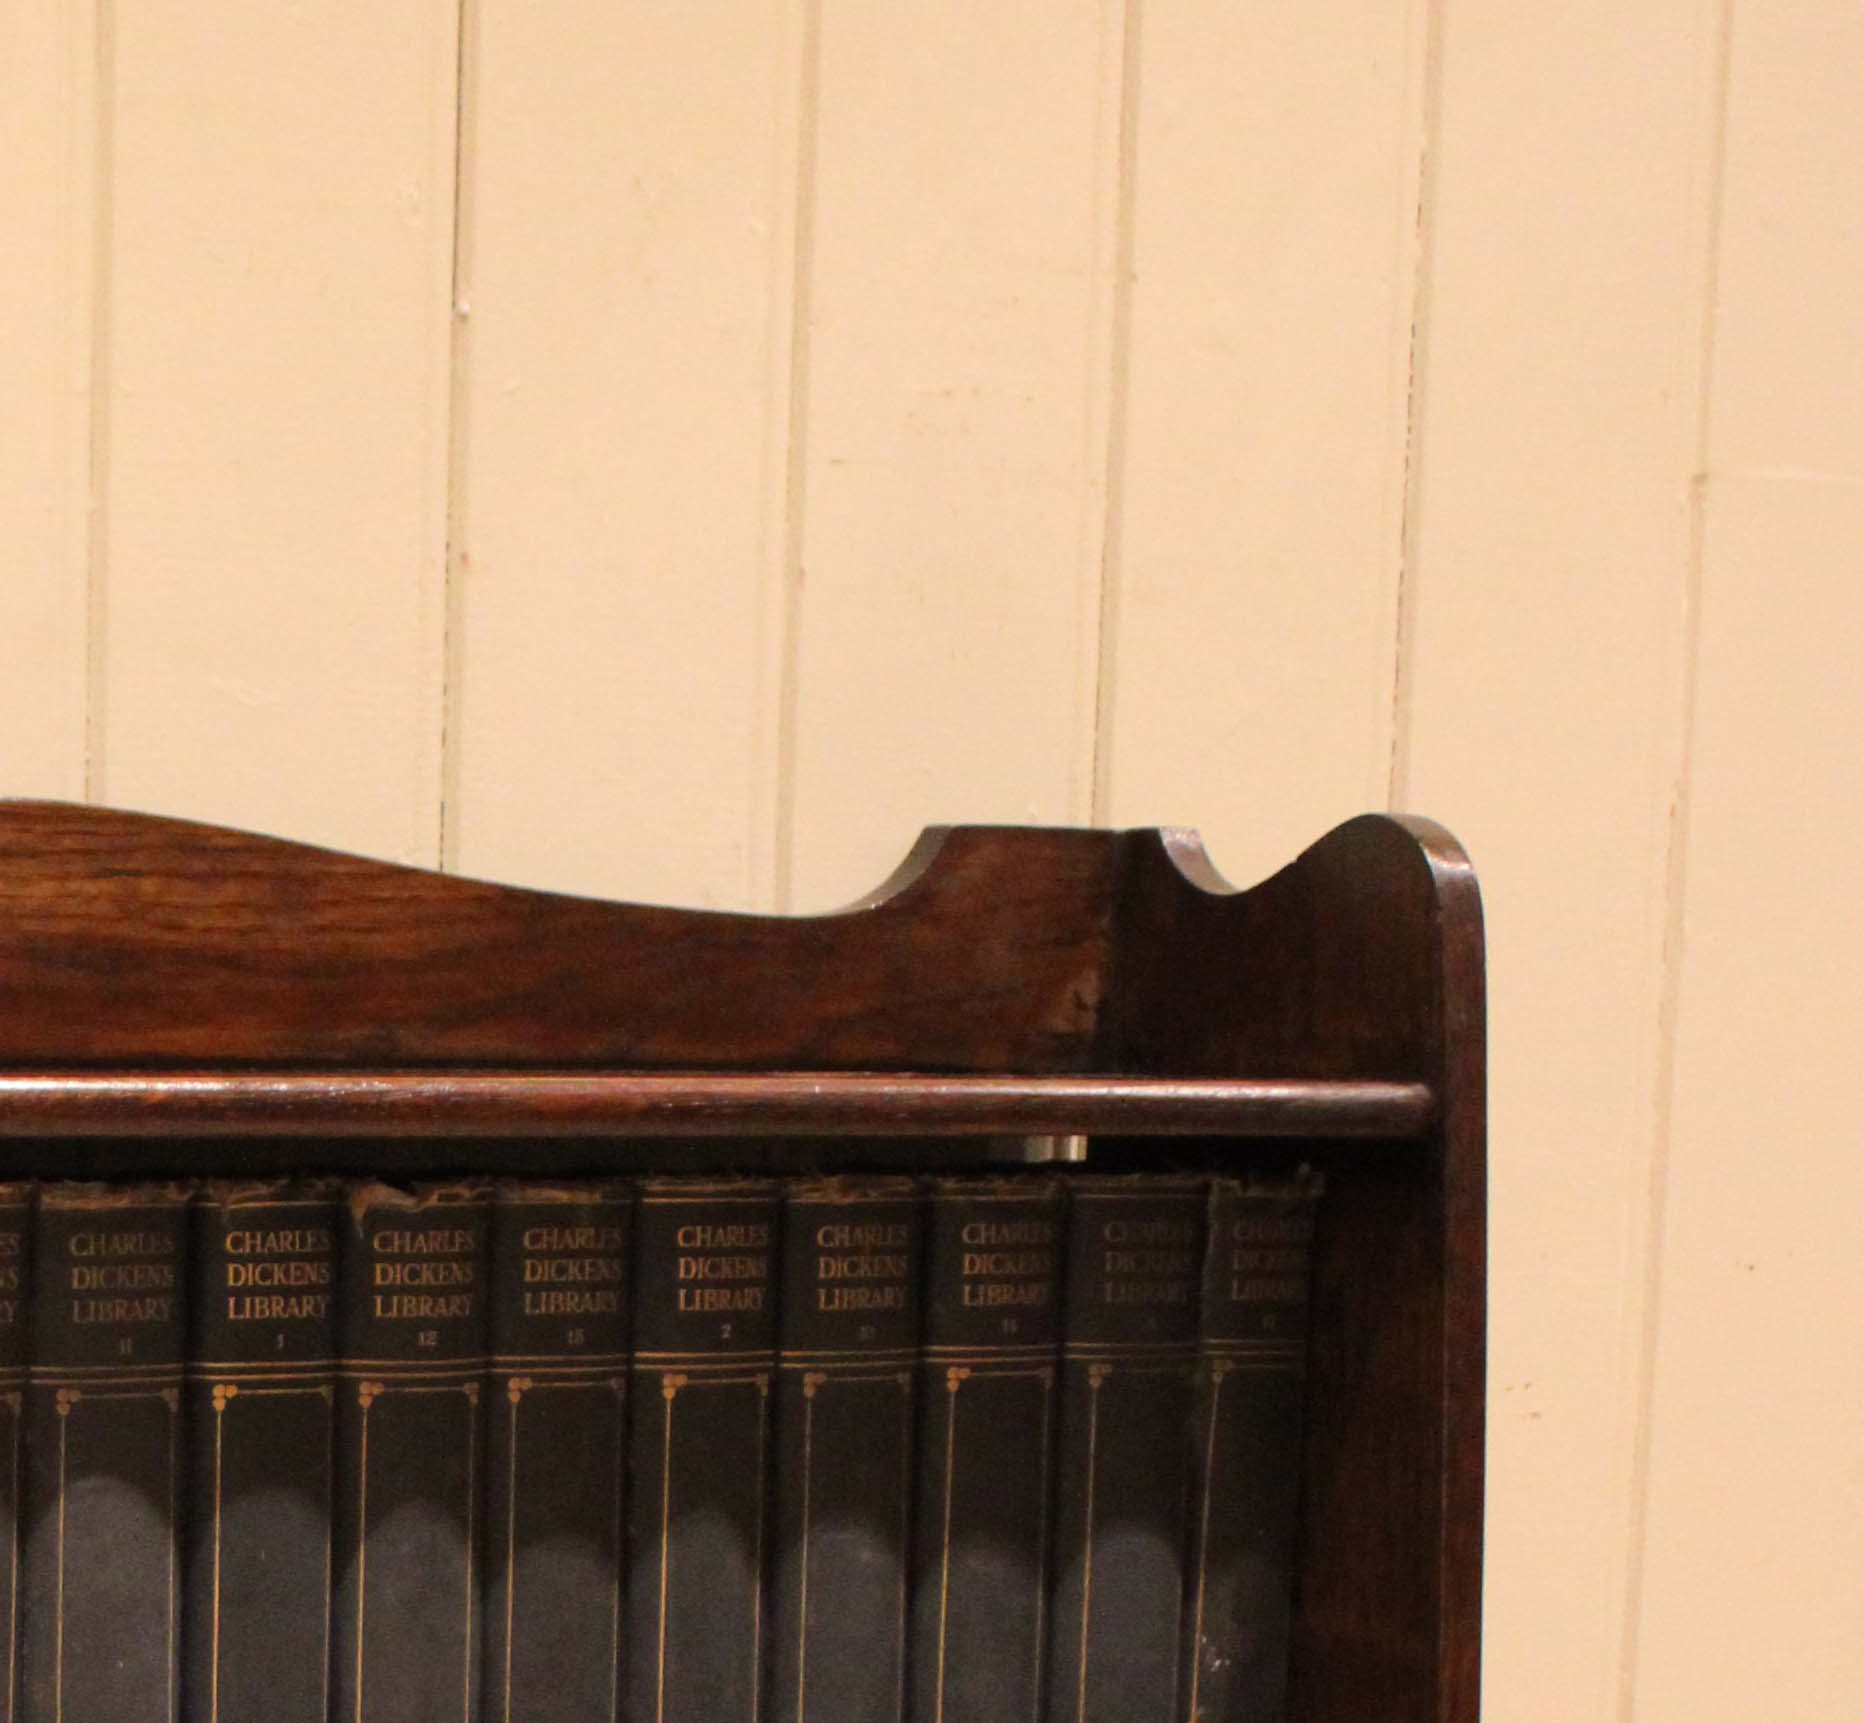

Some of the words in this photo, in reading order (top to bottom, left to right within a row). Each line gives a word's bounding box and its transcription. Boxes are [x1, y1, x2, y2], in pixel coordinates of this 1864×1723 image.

[69, 1232, 176, 1257] CHARLES
[225, 1230, 329, 1255] CHARLES
[372, 1230, 475, 1254] CHARLES
[71, 1266, 177, 1291] DICKENS
[226, 1263, 330, 1288] DICKENS
[374, 1263, 474, 1288] DICKENS
[72, 1299, 173, 1325] LIBRARY
[227, 1297, 329, 1321] LIBRARY
[374, 1295, 474, 1320] LIBRARY
